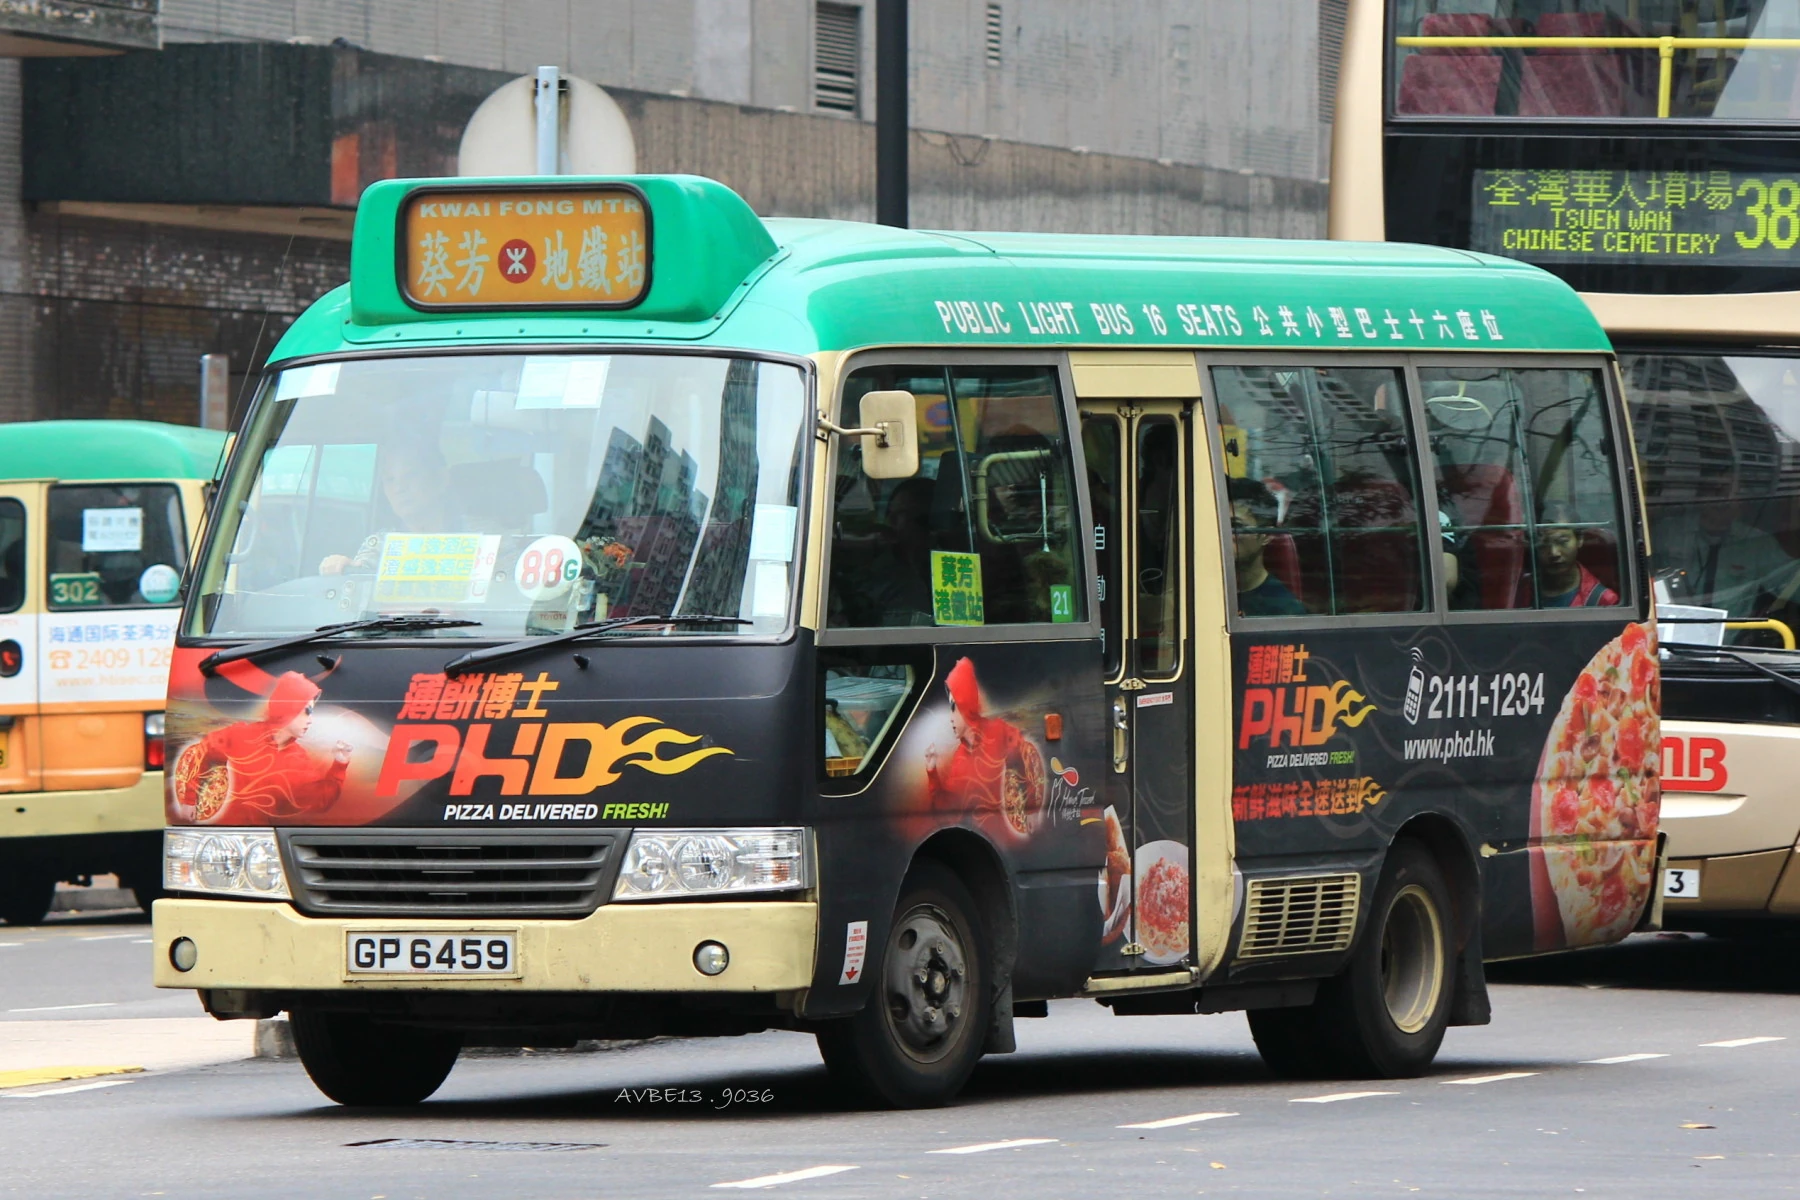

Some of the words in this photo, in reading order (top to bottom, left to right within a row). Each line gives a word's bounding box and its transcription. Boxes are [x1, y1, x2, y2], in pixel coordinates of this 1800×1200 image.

[420, 202, 491, 218] KWAI
[500, 201, 574, 216] FONG
[583, 199, 641, 215] MTR
[1551, 208, 1620, 231] TSUEN
[1628, 209, 1672, 231] WAN
[1503, 229, 1595, 251] CHINESE
[1603, 232, 1720, 254] CEMETERY
[417, 229, 491, 298] 葵芳
[542, 225, 645, 296] 地鐵站
[934, 300, 1012, 334] PUBLIC
[1018, 301, 1080, 335] LIGHT
[1089, 303, 1135, 336] BUS
[1142, 304, 1168, 336] 16
[1176, 304, 1243, 337] SEATS
[1252, 305, 1504, 341] 公共小型巴士十六座位
[54, 582, 98, 603] 302
[1053, 591, 1070, 615] 21
[77, 648, 130, 669] 2409
[397, 672, 559, 720] 薄餅博士
[1427, 672, 1545, 719] 2111-1234
[1239, 685, 1338, 750] PHD
[374, 722, 622, 796] PHD
[1267, 754, 1288, 768] PIZZA
[1289, 752, 1328, 767] DELIVERED
[1329, 750, 1355, 766] FRESH!
[1404, 729, 1495, 764] www.phd.hk
[443, 804, 494, 821] PIZZA
[499, 804, 599, 821] DELIVERED
[602, 802, 669, 820] FRESH!
[1668, 870, 1685, 893] 3
[355, 938, 400, 969] GP
[410, 938, 508, 970] 6459
